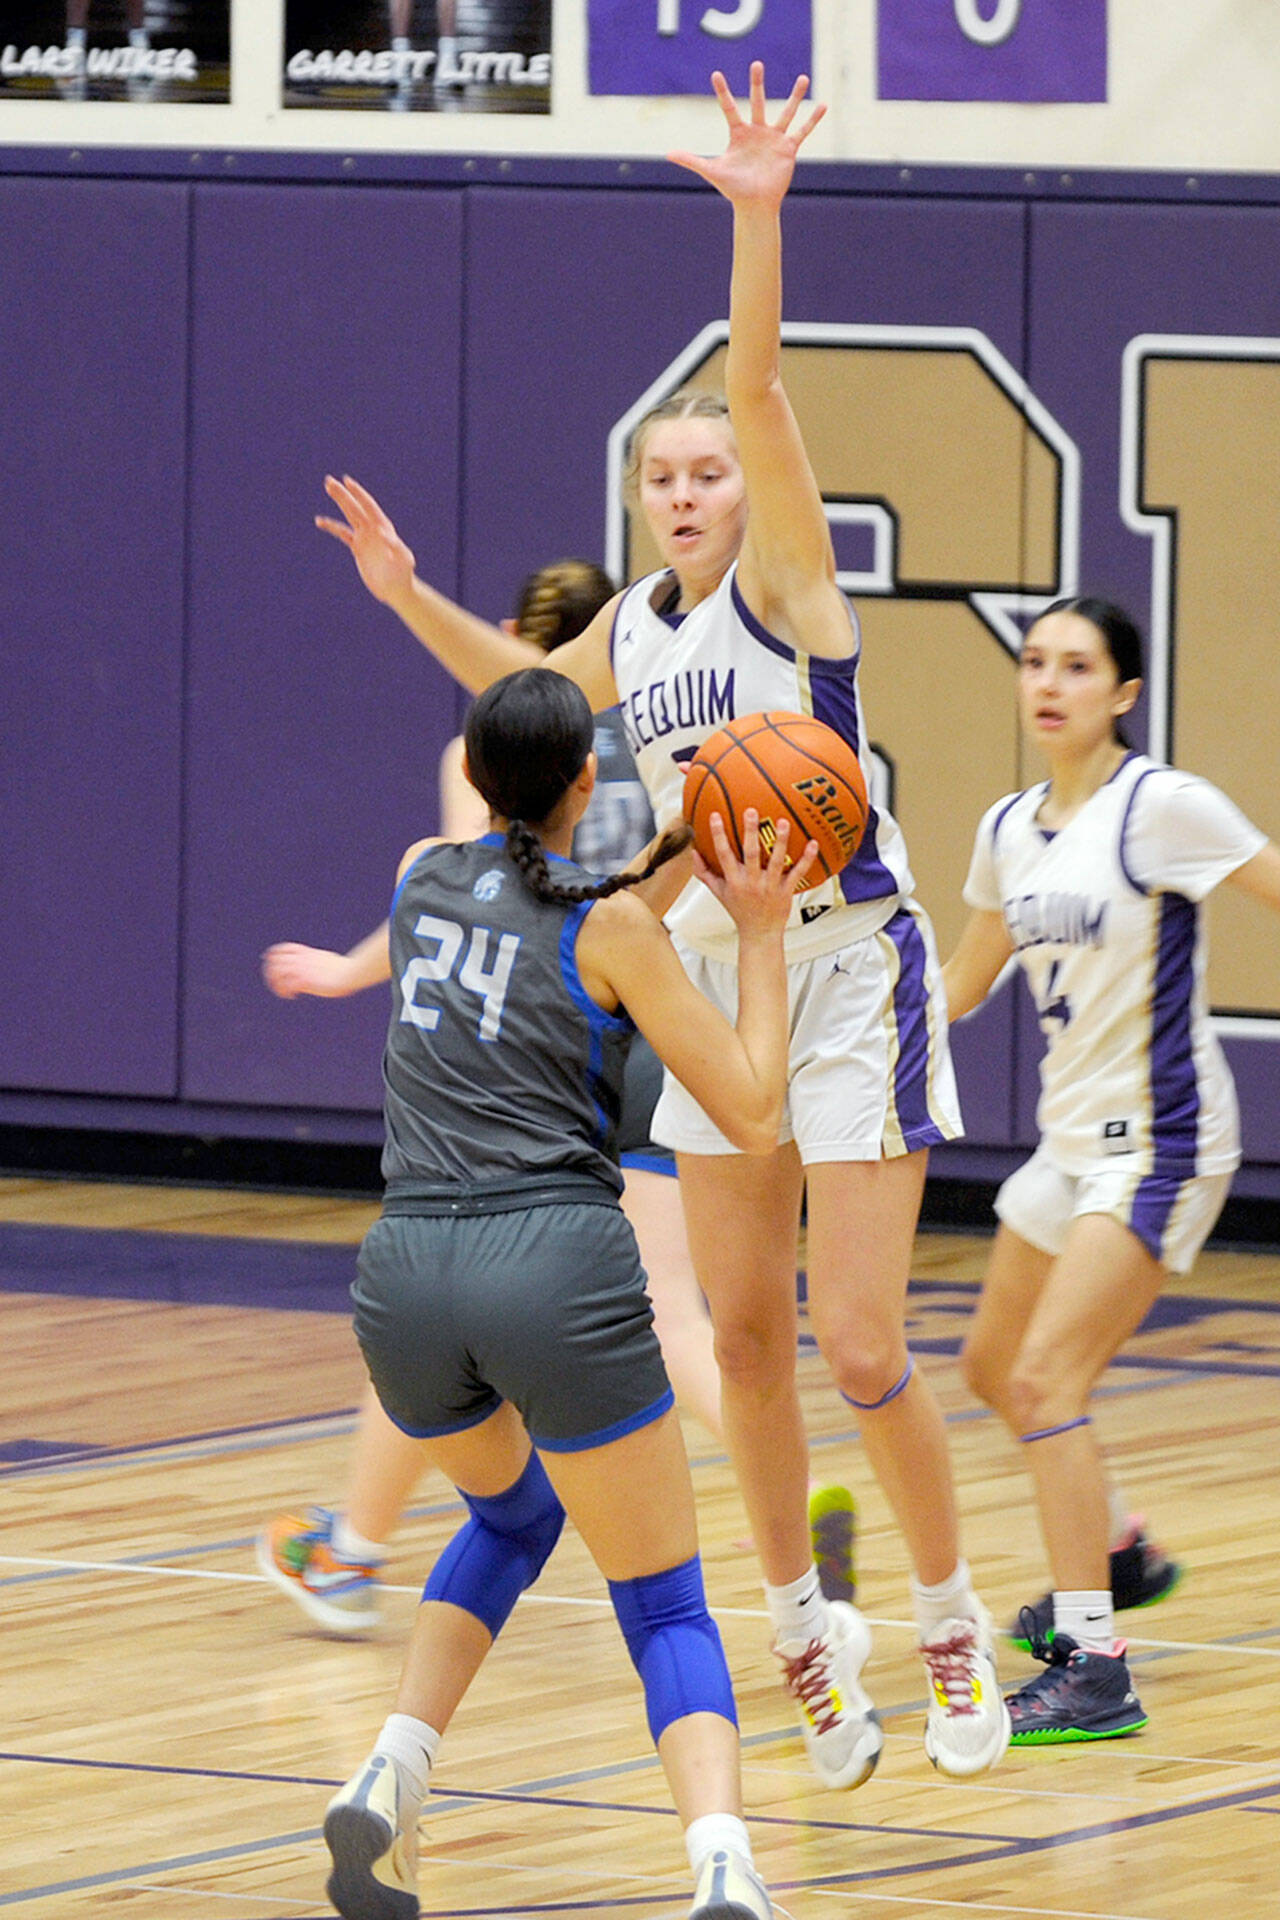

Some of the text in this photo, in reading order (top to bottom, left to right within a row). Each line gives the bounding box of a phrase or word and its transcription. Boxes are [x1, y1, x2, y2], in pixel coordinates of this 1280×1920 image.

[1, 44, 199, 81] LARS WIKER
[287, 49, 551, 84] GARRETT LITTLE
[400, 914, 523, 1043] 24
